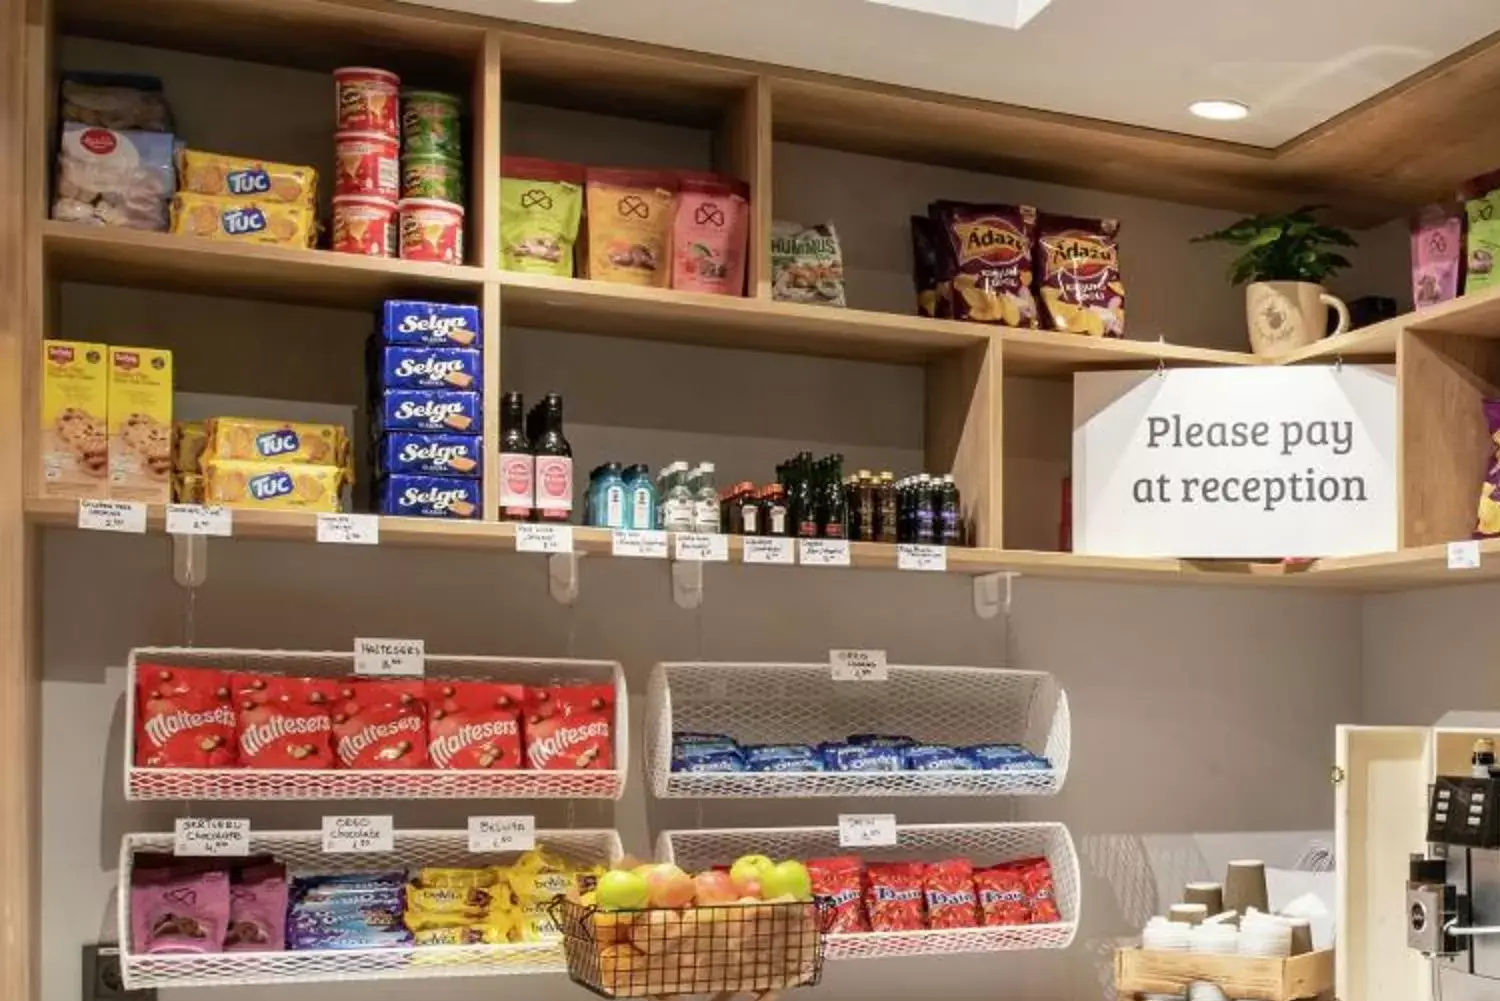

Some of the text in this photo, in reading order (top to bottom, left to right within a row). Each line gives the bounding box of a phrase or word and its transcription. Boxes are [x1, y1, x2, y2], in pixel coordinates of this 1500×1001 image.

[398, 315, 468, 337] Selga
[395, 358, 464, 380] Selga
[395, 401, 464, 423] Selga
[400, 442, 468, 464] Selga
[1147, 415, 1353, 455] Please pay
[400, 488, 468, 509] Selga
[1133, 468, 1367, 510] at reception
[144, 708, 237, 748] Maltesers
[240, 713, 332, 758] Maltesers
[336, 714, 422, 761] Maltesers
[429, 718, 518, 762] Maltesers
[526, 719, 609, 769] Maltesers
